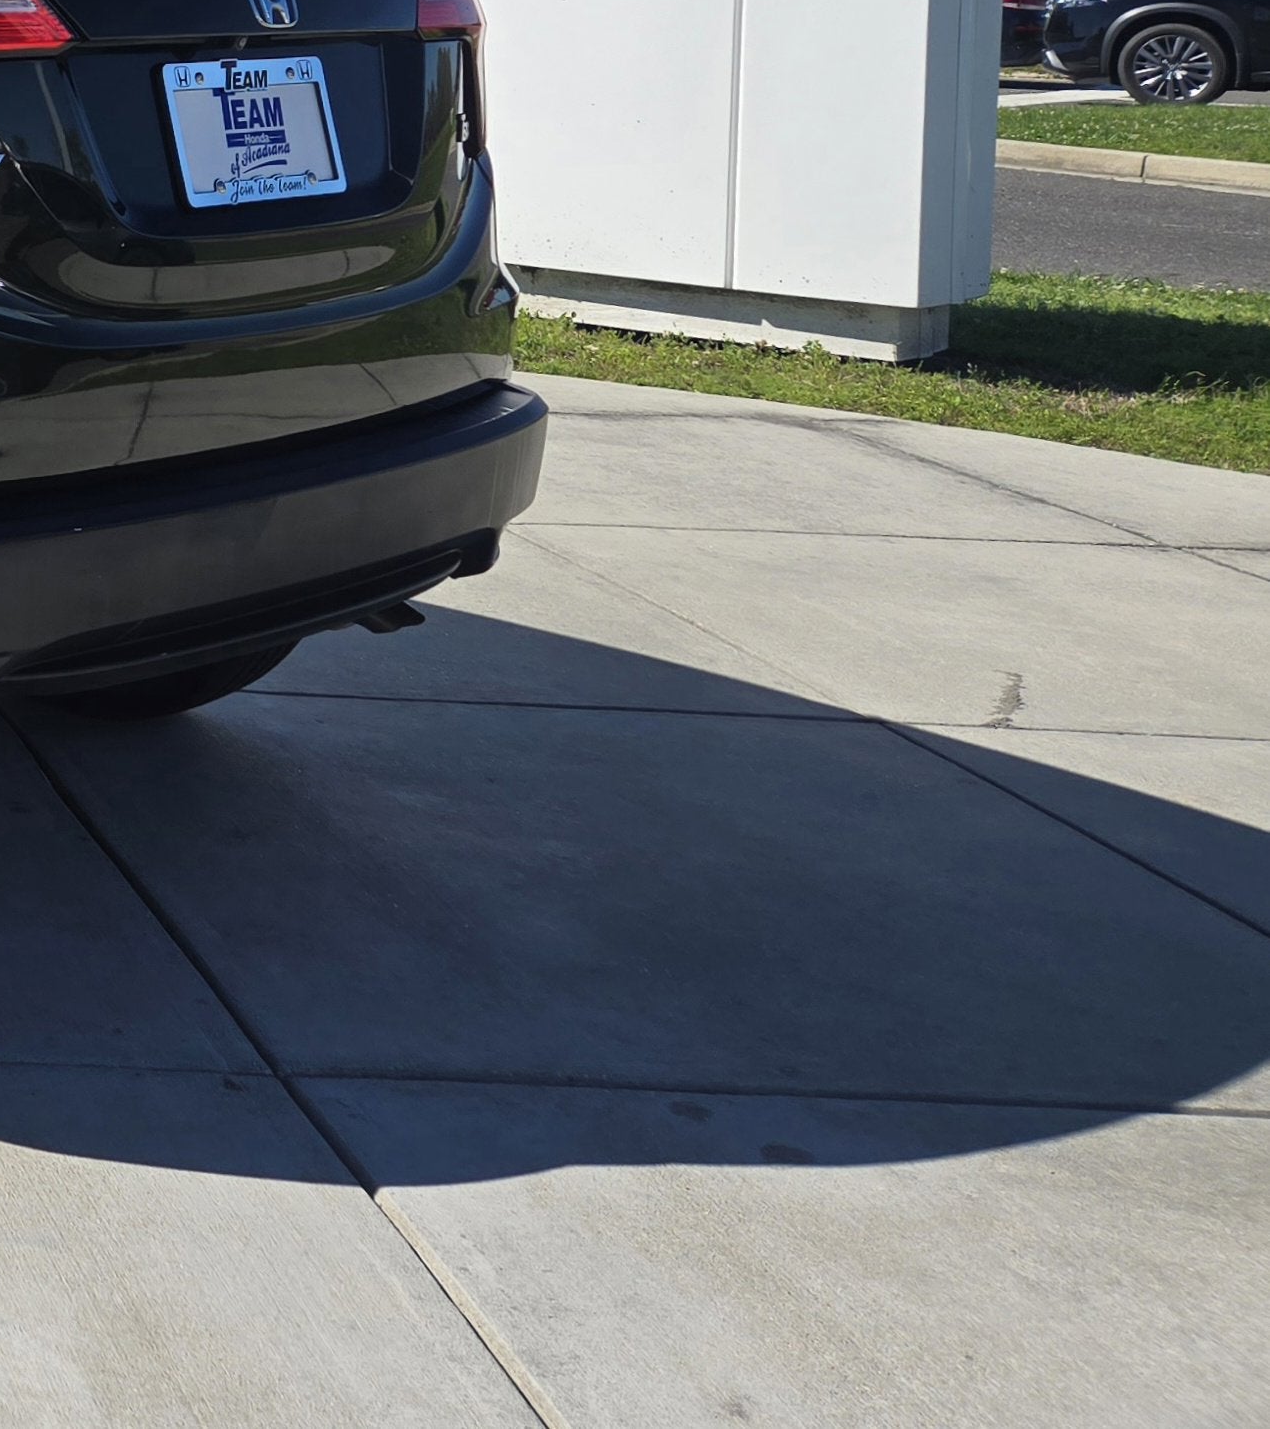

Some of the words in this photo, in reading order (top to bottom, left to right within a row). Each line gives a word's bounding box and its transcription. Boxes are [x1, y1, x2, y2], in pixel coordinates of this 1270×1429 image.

[220, 60, 268, 90] TEAM
[212, 88, 284, 130] TEAM
[243, 133, 270, 145] Honda
[231, 153, 240, 178] of
[241, 143, 291, 167] Acadiana
[230, 179, 254, 203] Join
